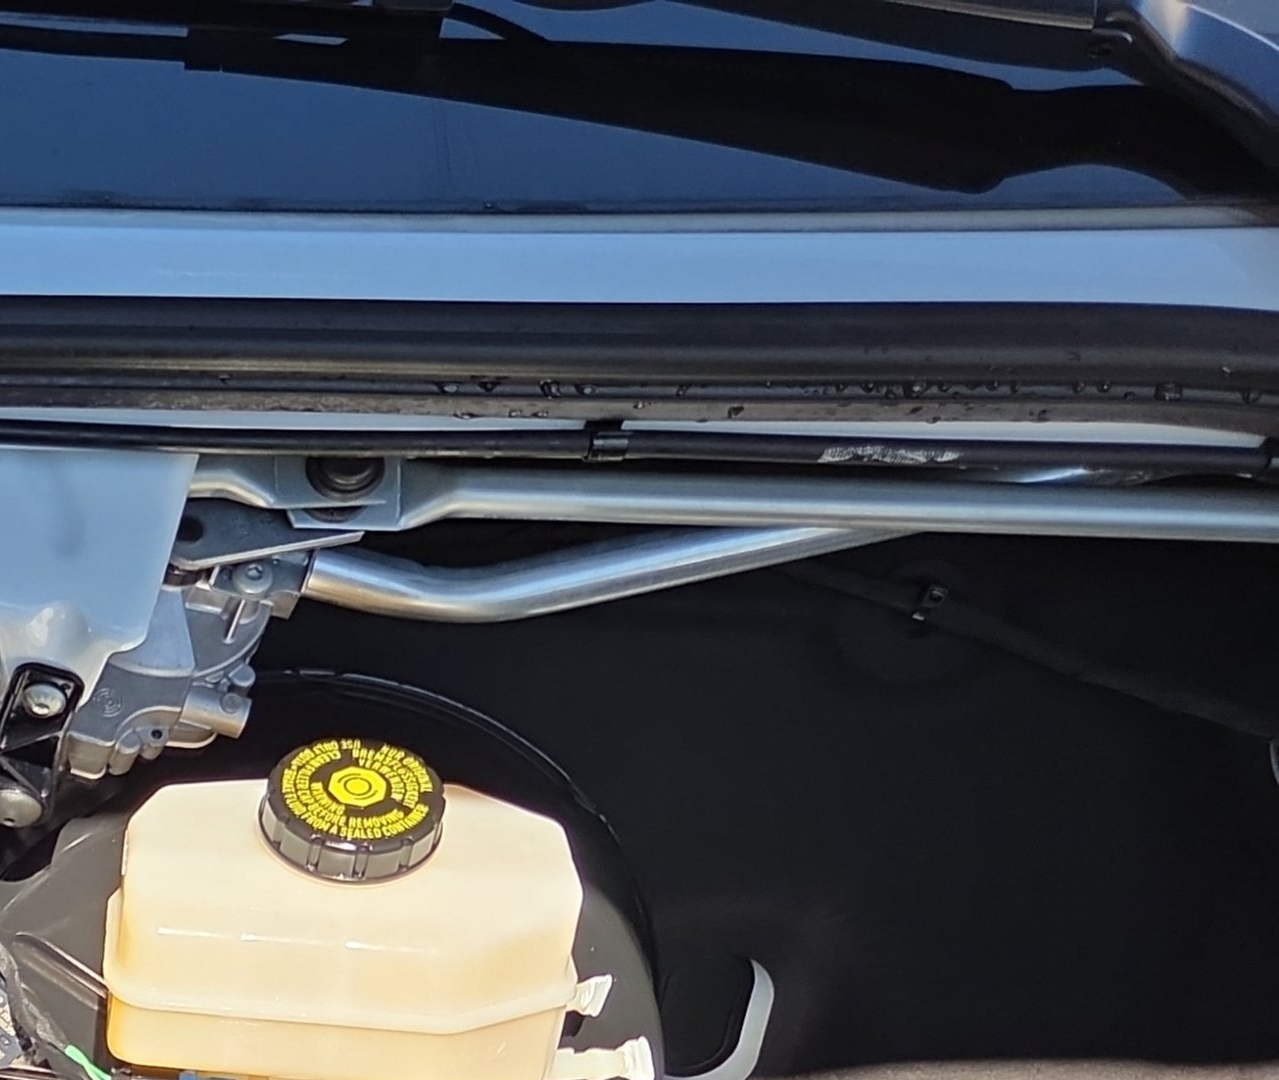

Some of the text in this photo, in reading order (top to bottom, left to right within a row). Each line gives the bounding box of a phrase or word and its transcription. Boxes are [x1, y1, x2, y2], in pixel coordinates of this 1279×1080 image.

[300, 812, 331, 831] FROM
[329, 825, 338, 834] A
[339, 826, 382, 839] SEALED
[308, 803, 347, 827] BEFORE
[348, 809, 404, 828] REMOVING
